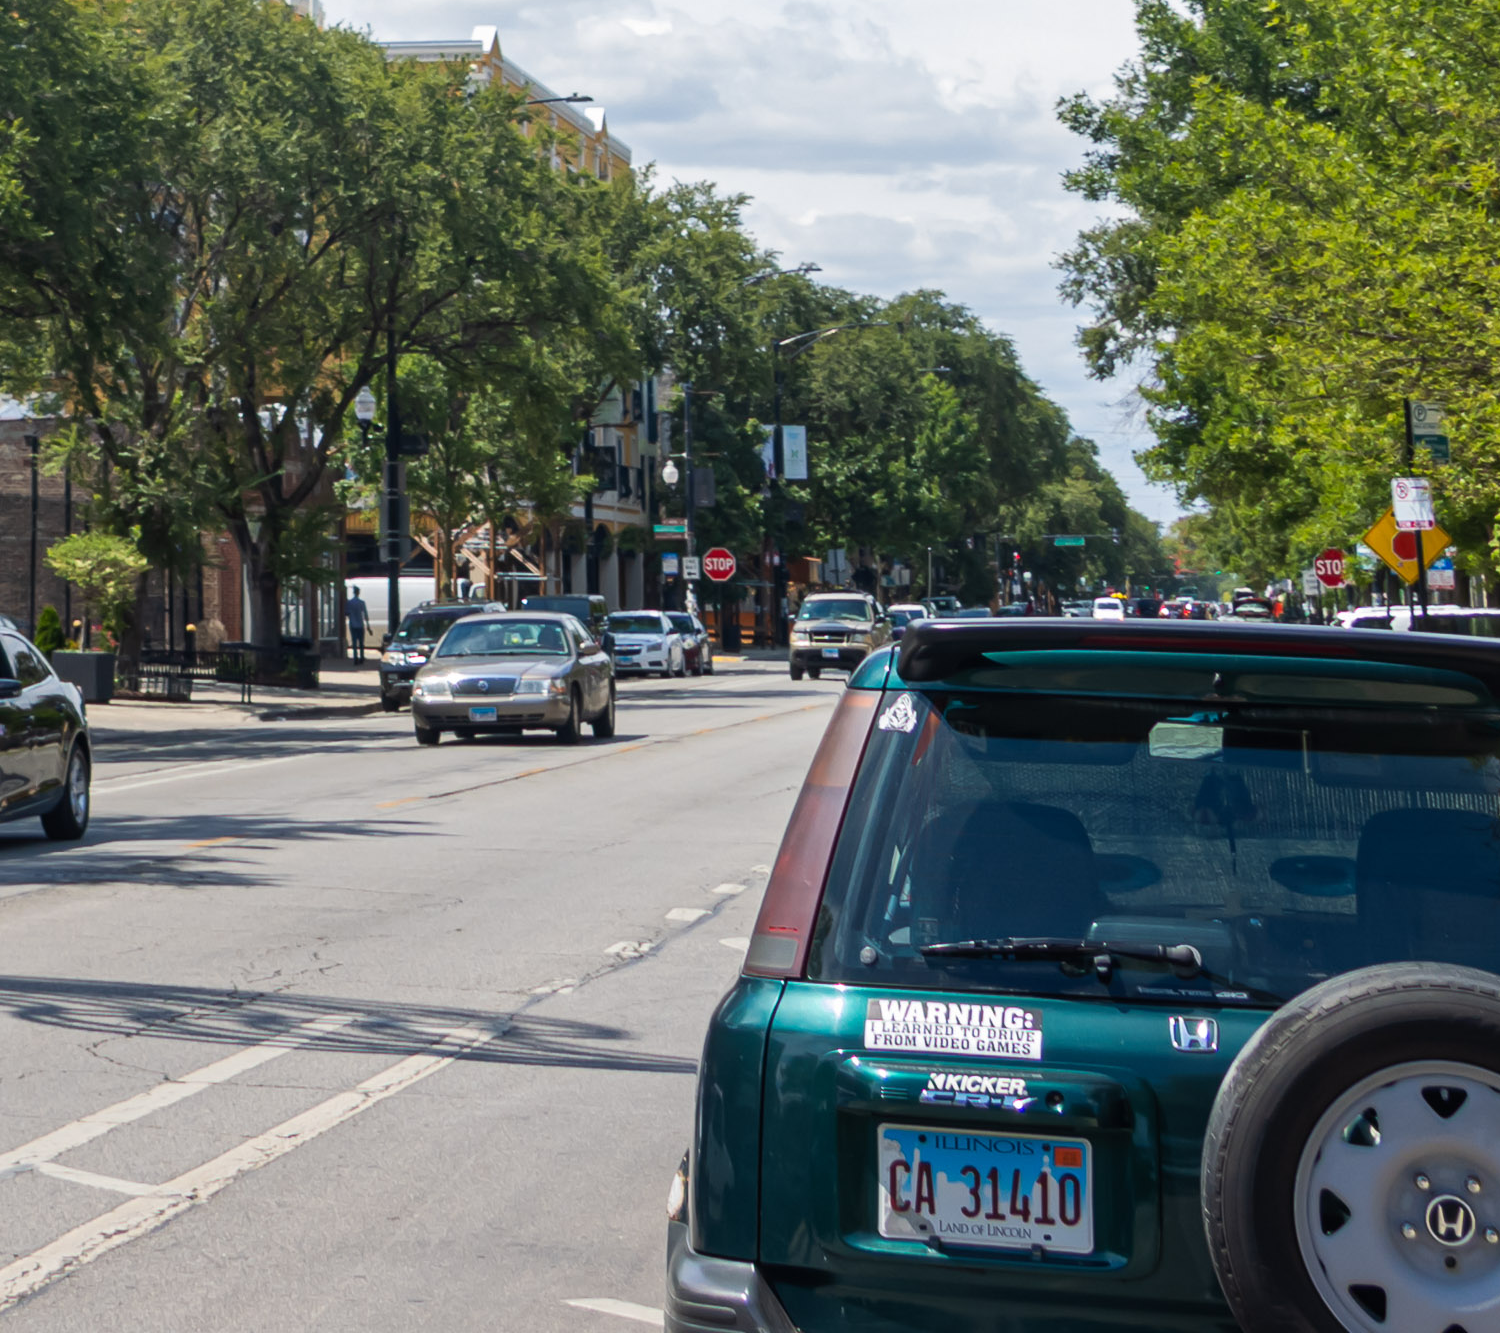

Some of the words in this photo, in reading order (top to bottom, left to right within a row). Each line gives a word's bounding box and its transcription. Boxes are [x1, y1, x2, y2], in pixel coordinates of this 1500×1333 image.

[705, 558, 733, 571] STOP
[1316, 559, 1346, 575] STO
[879, 999, 1034, 1030] WARNING:
[871, 1022, 876, 1032] I
[882, 1022, 954, 1036] LEARNED
[960, 1026, 981, 1038] TO
[987, 1028, 1036, 1042] DRIVE
[873, 1033, 917, 1047] FROM
[924, 1036, 970, 1050] VIDEO
[976, 1039, 1031, 1055] GAMES
[944, 1074, 1026, 1096] KICKER
[935, 1135, 1035, 1155] ILLINOIS
[889, 1159, 936, 1215] CA
[960, 1165, 1082, 1227] 31410
[939, 1219, 969, 1234] LAND
[971, 1223, 985, 1235] OF
[987, 1222, 1032, 1239] LINCOLN
